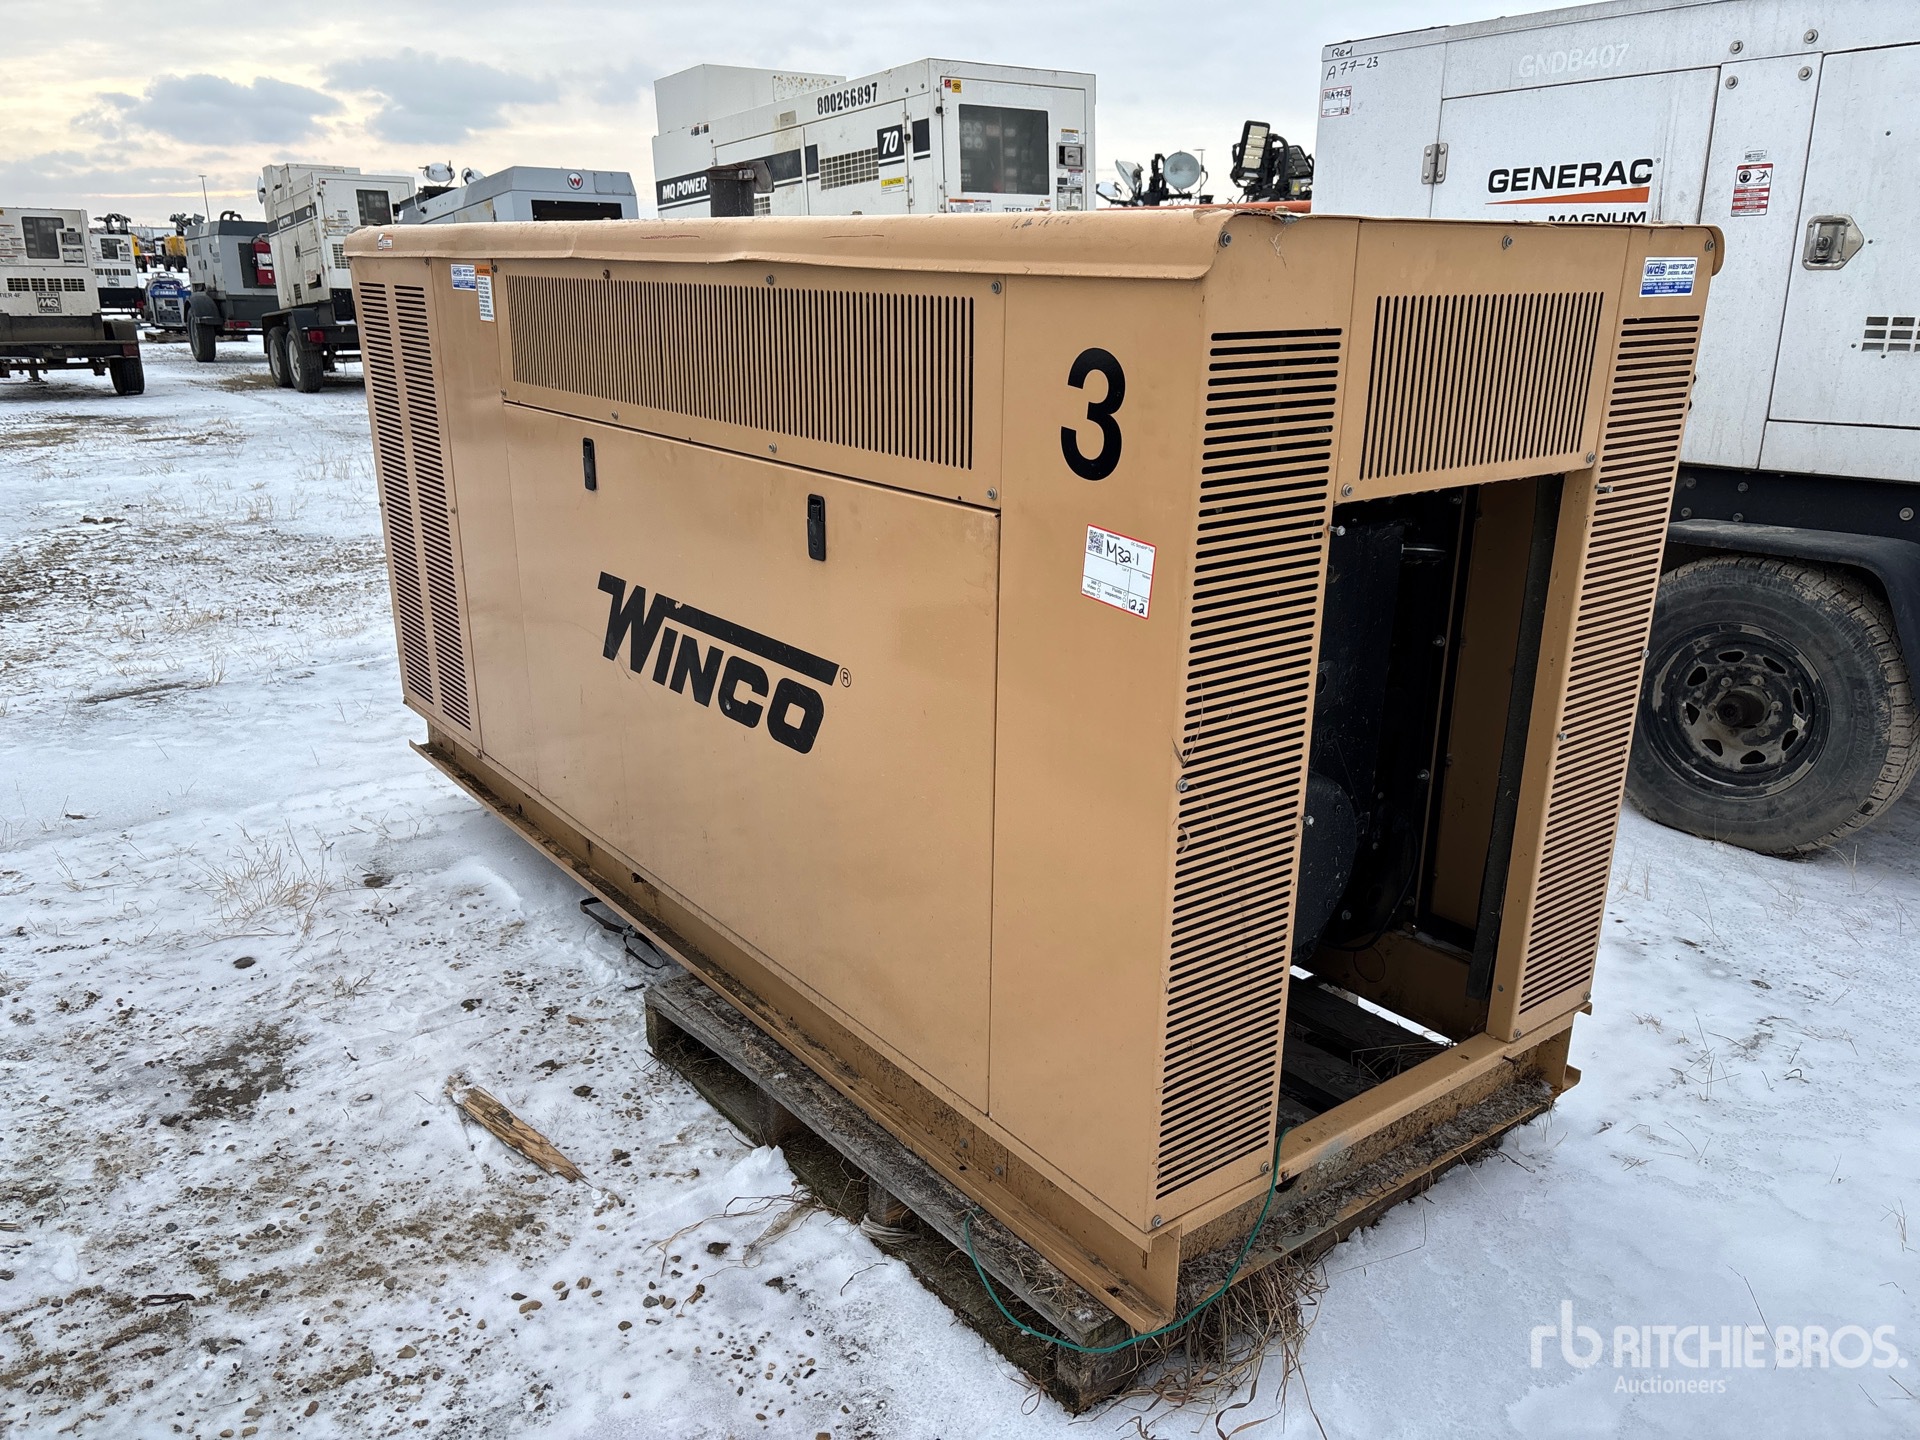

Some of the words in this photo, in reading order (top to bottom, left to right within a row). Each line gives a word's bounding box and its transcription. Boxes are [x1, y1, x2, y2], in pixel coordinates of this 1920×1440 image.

[1331, 46, 1353, 58] Red
[1518, 43, 1630, 78] GNDB407
[817, 82, 878, 115] 800266897
[882, 131, 900, 155] 70
[662, 184, 676, 200] MQ
[676, 176, 707, 196] POWER
[1488, 158, 1654, 194] GENERAC
[1549, 211, 1647, 224] MAGNUM
[39, 298, 59, 308] MQ
[1061, 347, 1126, 481] 3
[1106, 539, 1139, 566] M32.1
[1128, 598, 1145, 615] 12.2
[597, 571, 840, 754] WINCO
